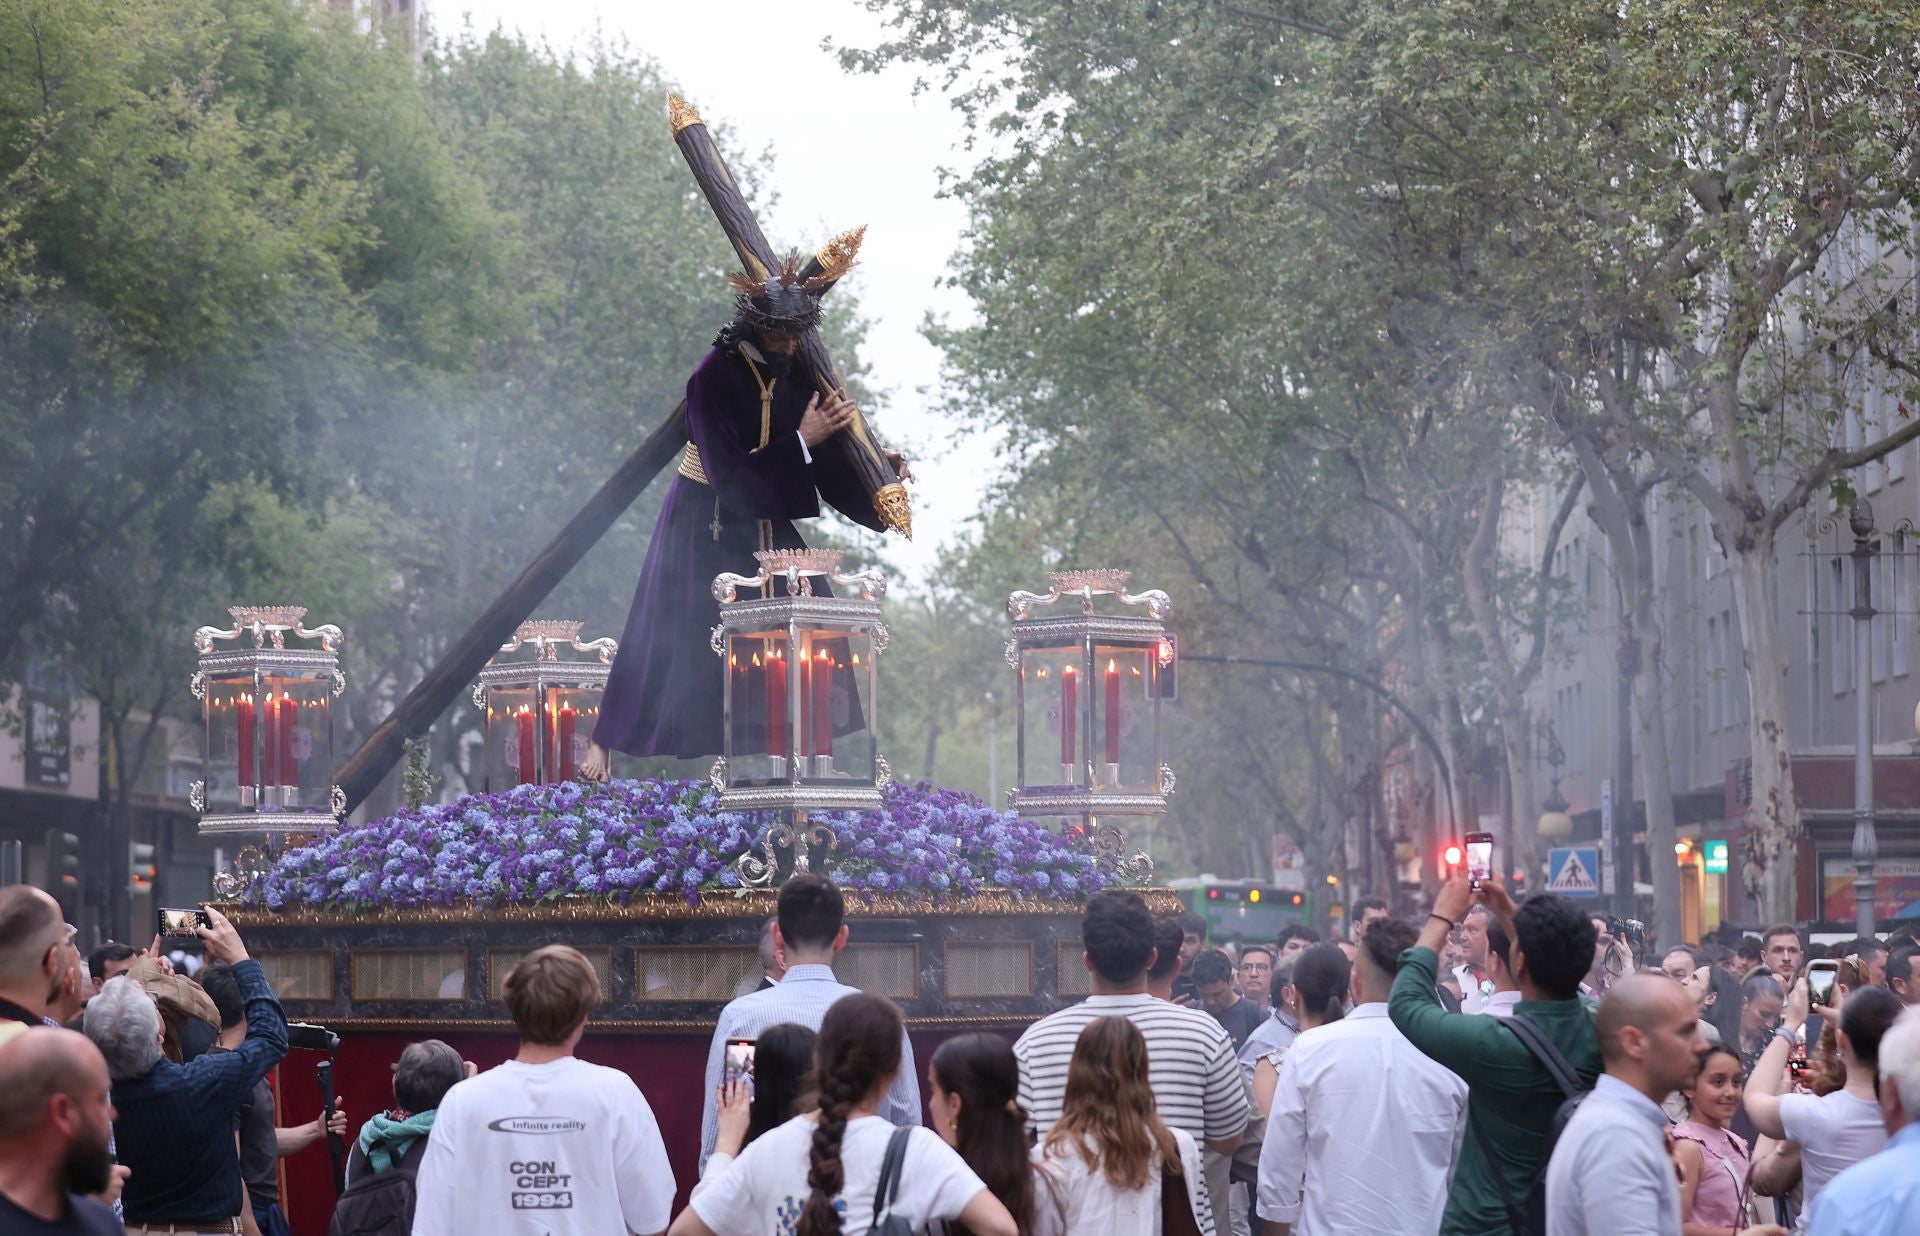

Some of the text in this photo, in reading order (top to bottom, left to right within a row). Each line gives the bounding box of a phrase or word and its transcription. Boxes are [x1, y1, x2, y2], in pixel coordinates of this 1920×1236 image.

[551, 1121, 586, 1130] reality
[509, 1161, 555, 1174] CON
[516, 1174, 571, 1188] CEPT
[513, 1193, 571, 1207] 1994
